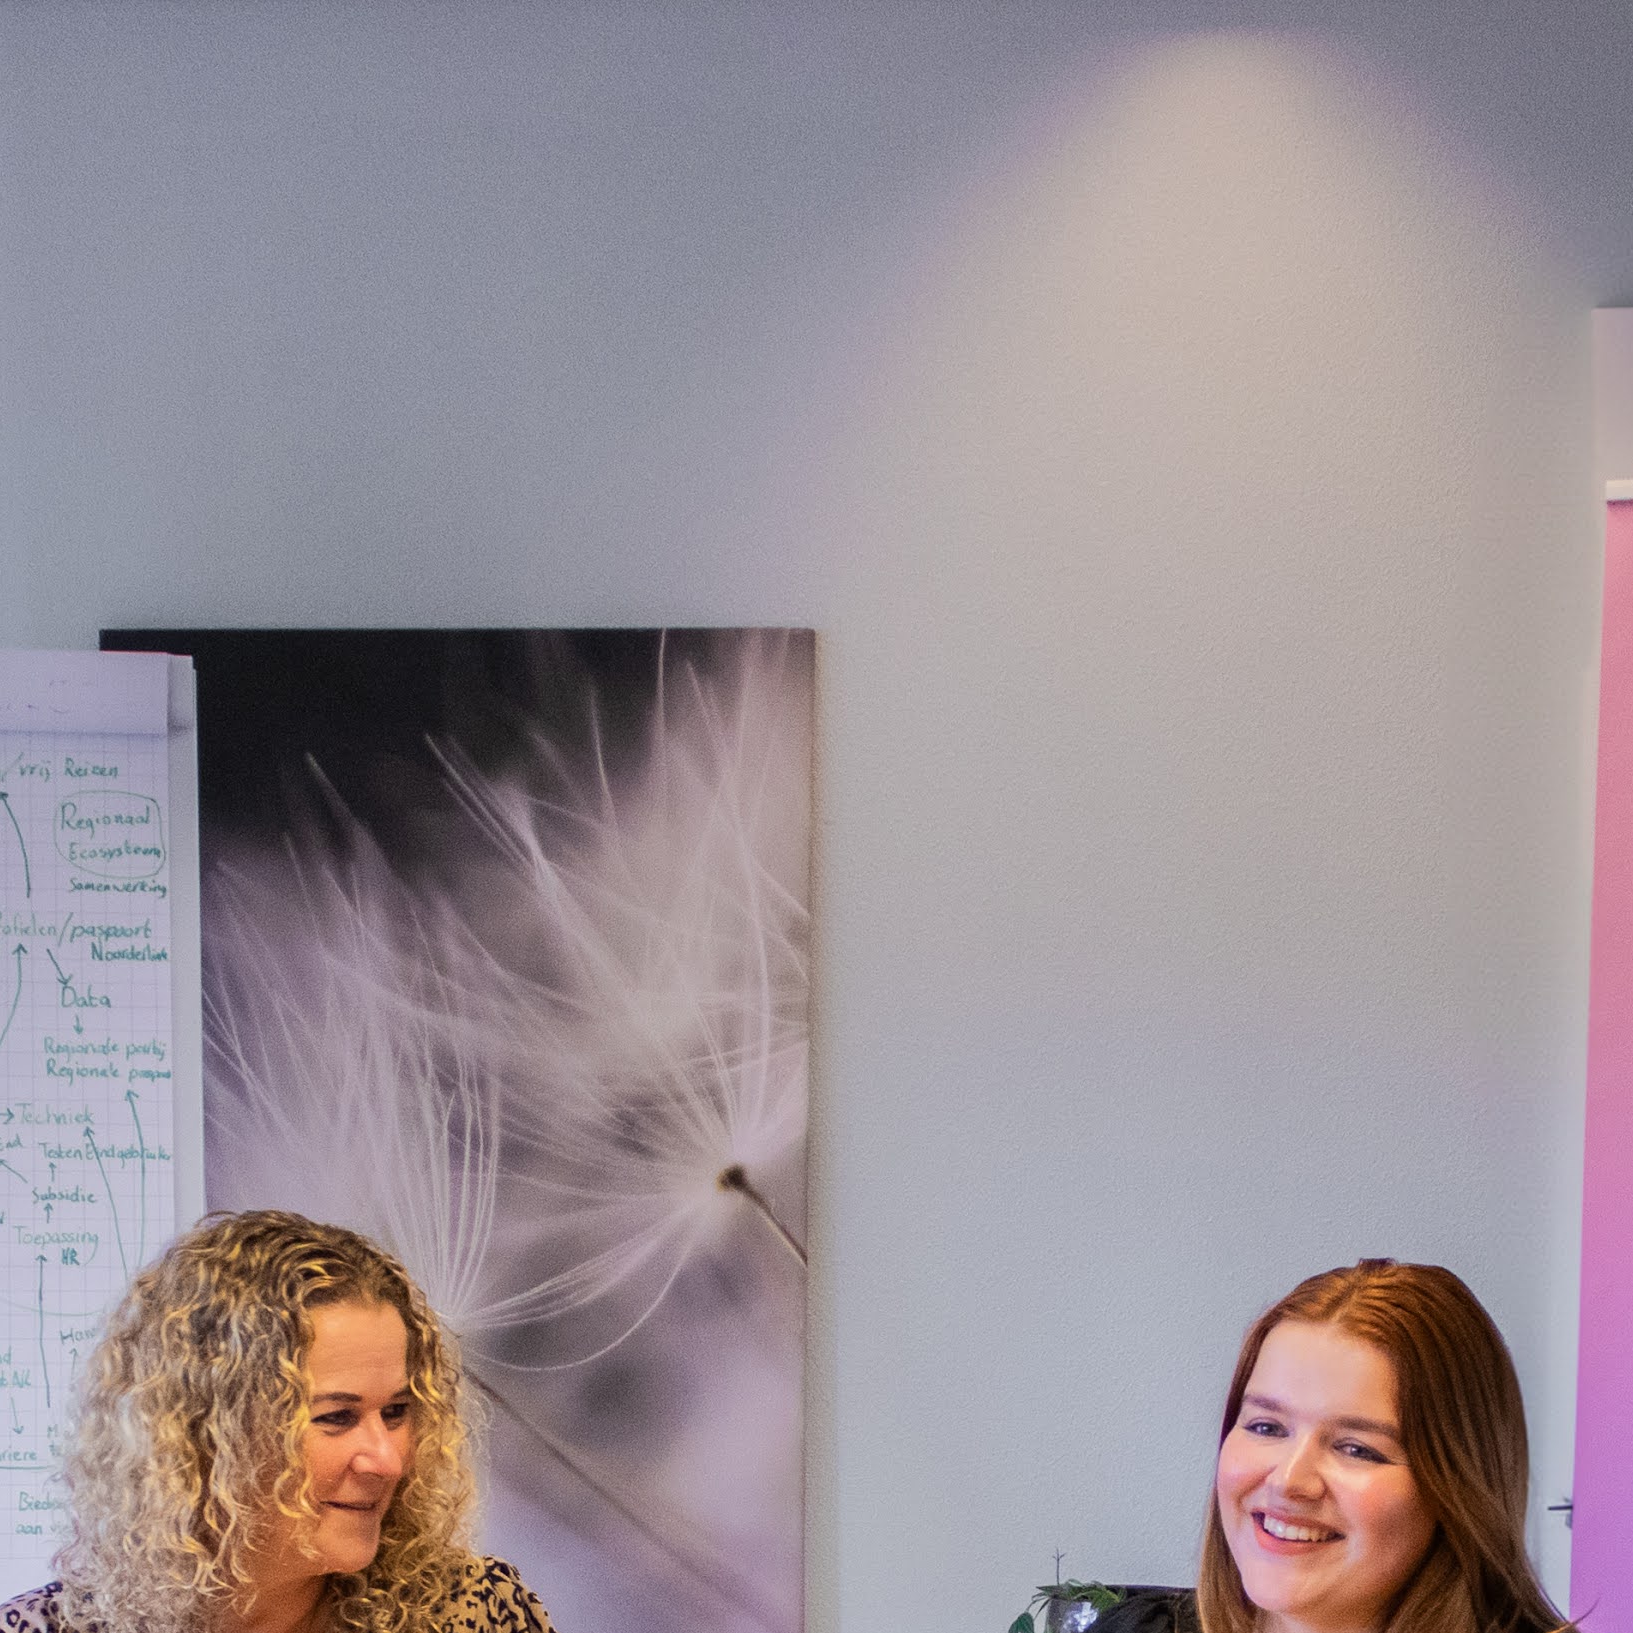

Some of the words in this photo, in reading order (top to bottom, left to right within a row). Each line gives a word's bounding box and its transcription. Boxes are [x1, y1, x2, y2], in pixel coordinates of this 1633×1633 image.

[61, 801, 151, 842] Regionaal
[61, 984, 112, 1009] Data
[15, 1102, 95, 1125] Techniek
[14, 1225, 100, 1250] Toepassing
